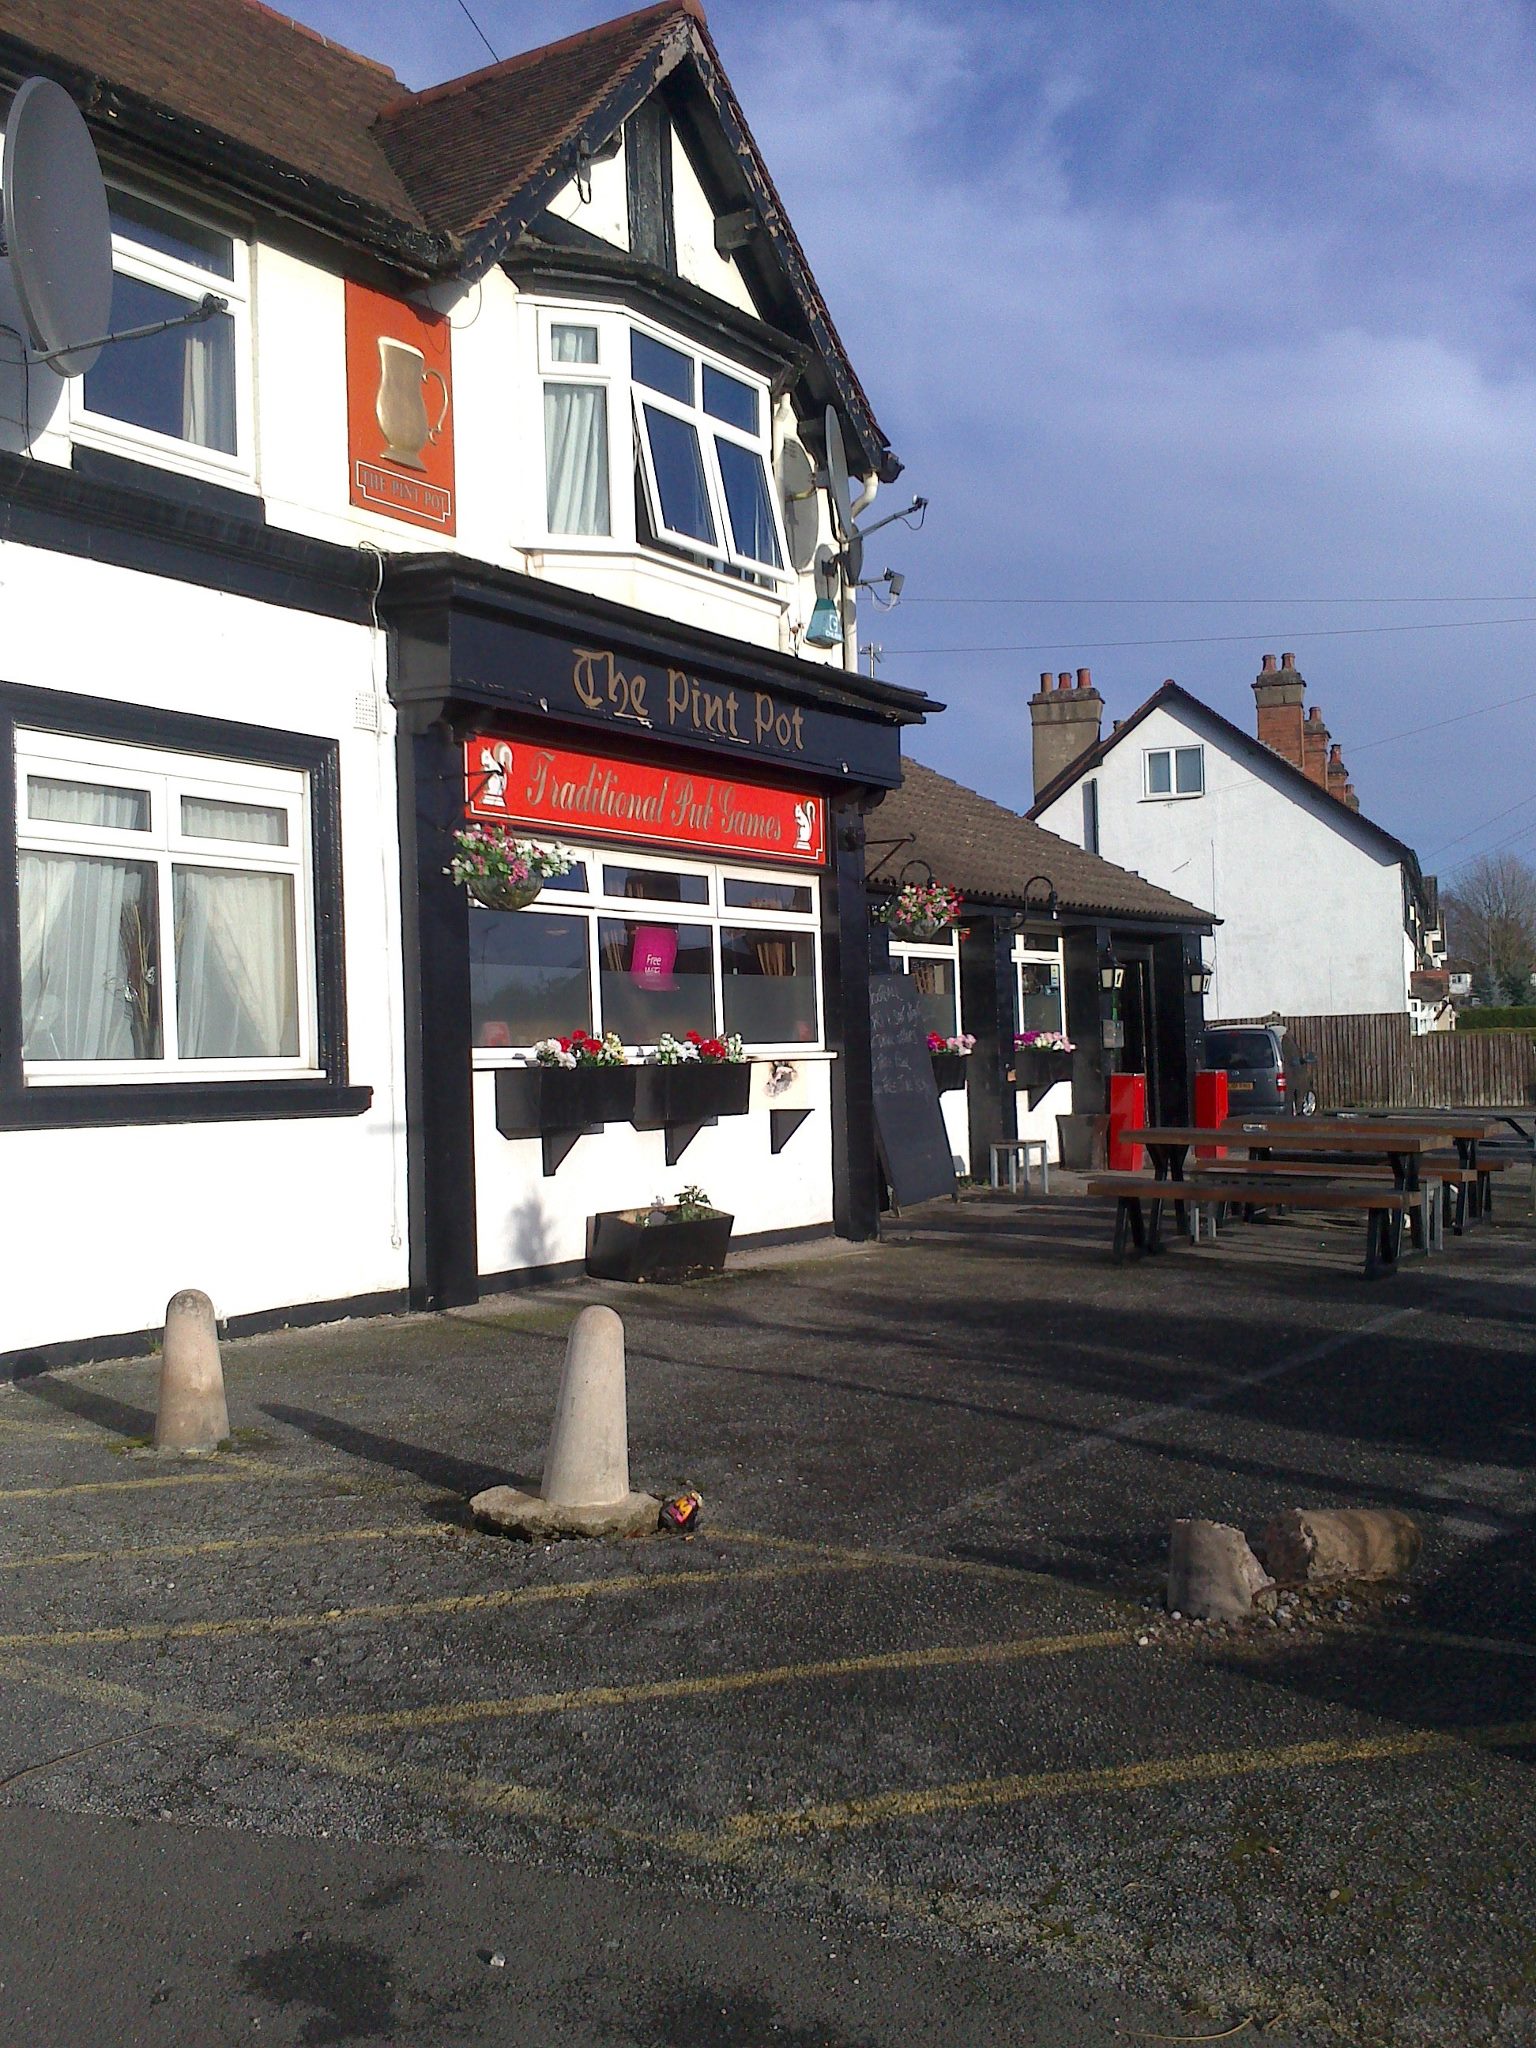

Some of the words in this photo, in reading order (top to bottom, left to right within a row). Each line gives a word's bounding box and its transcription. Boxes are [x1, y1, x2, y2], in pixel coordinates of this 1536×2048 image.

[363, 471, 385, 491] THE
[392, 480, 418, 502] PINT
[424, 491, 445, 513] POT
[573, 649, 649, 716] The
[667, 668, 739, 737] Pint
[754, 692, 804, 750] Pot
[526, 751, 670, 824] Traditional
[671, 776, 715, 833] Pub
[718, 785, 782, 841] Games
[646, 953, 662, 966] Free
